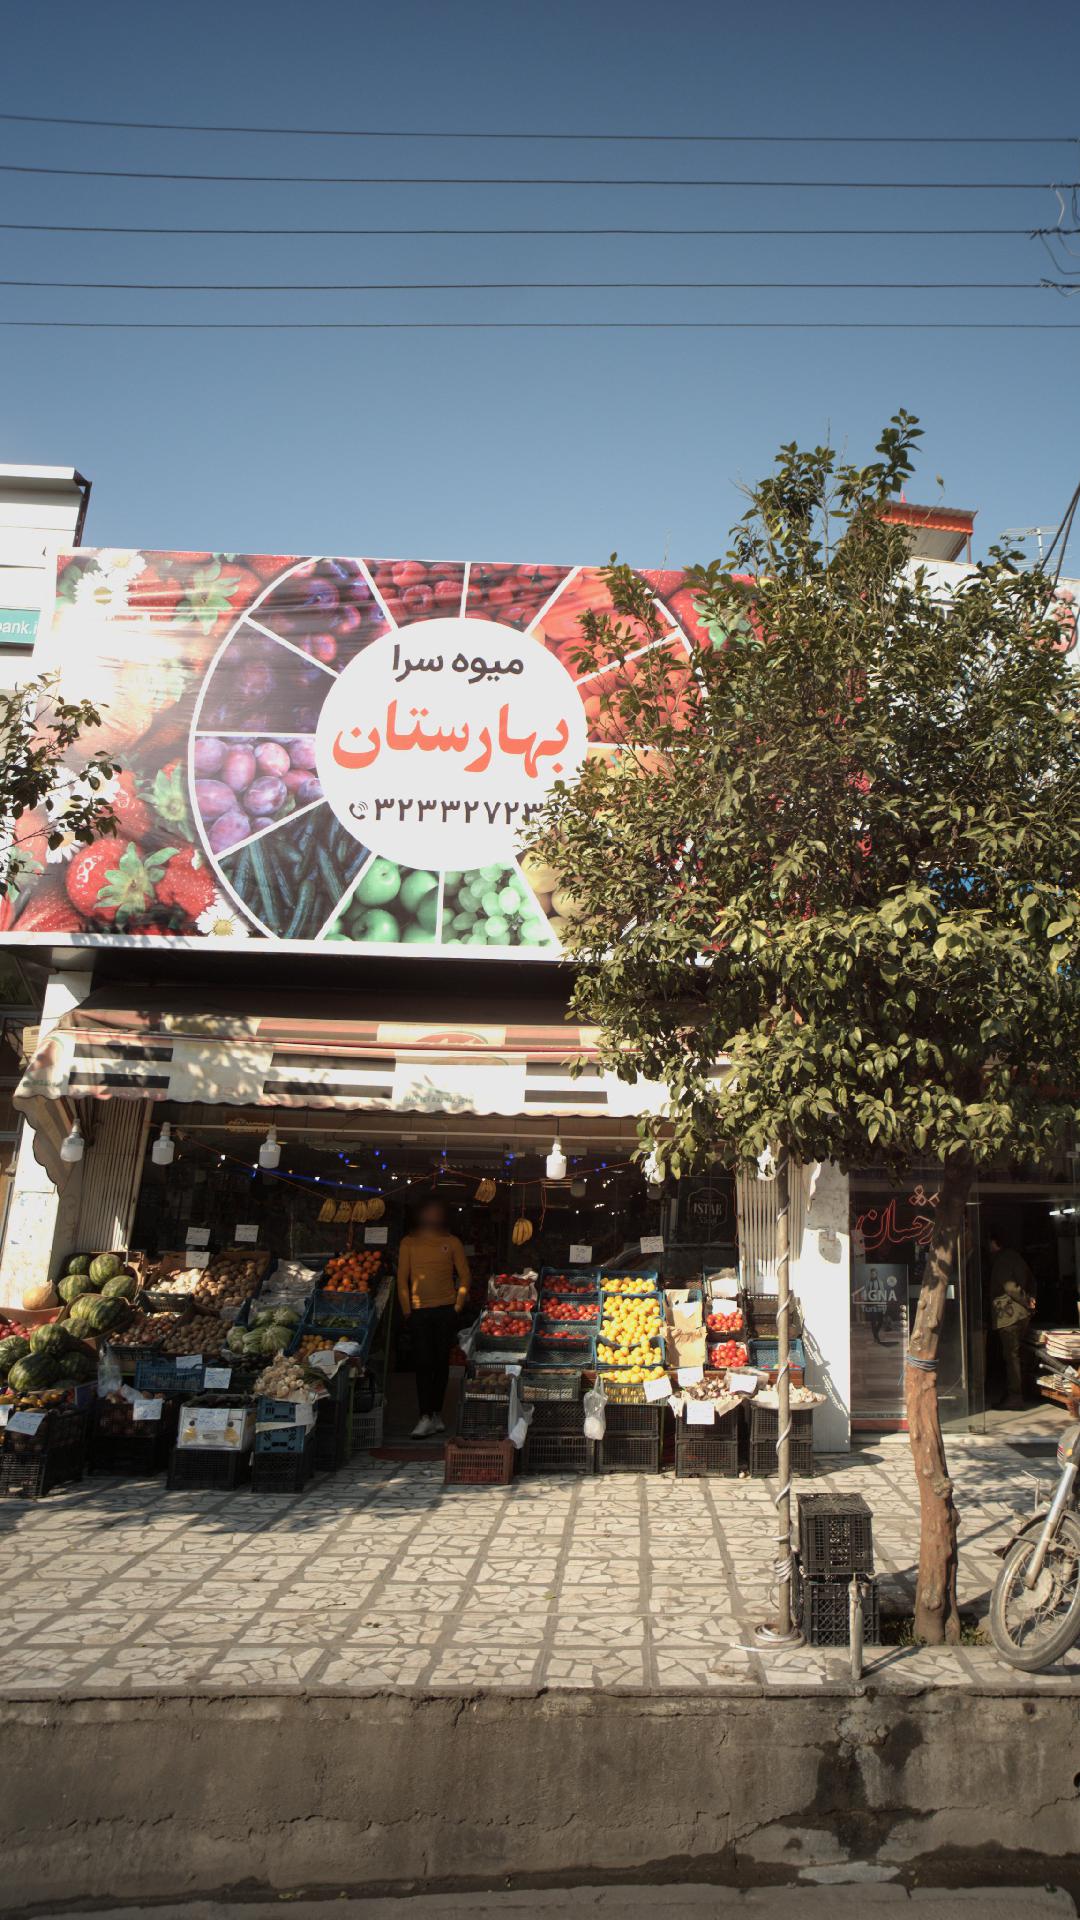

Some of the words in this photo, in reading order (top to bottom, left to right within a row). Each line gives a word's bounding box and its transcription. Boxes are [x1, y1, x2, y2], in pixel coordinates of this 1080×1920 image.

[392, 644, 444, 683] سرا
[451, 652, 525, 684] میوه
[332, 699, 570, 779] بهارستان
